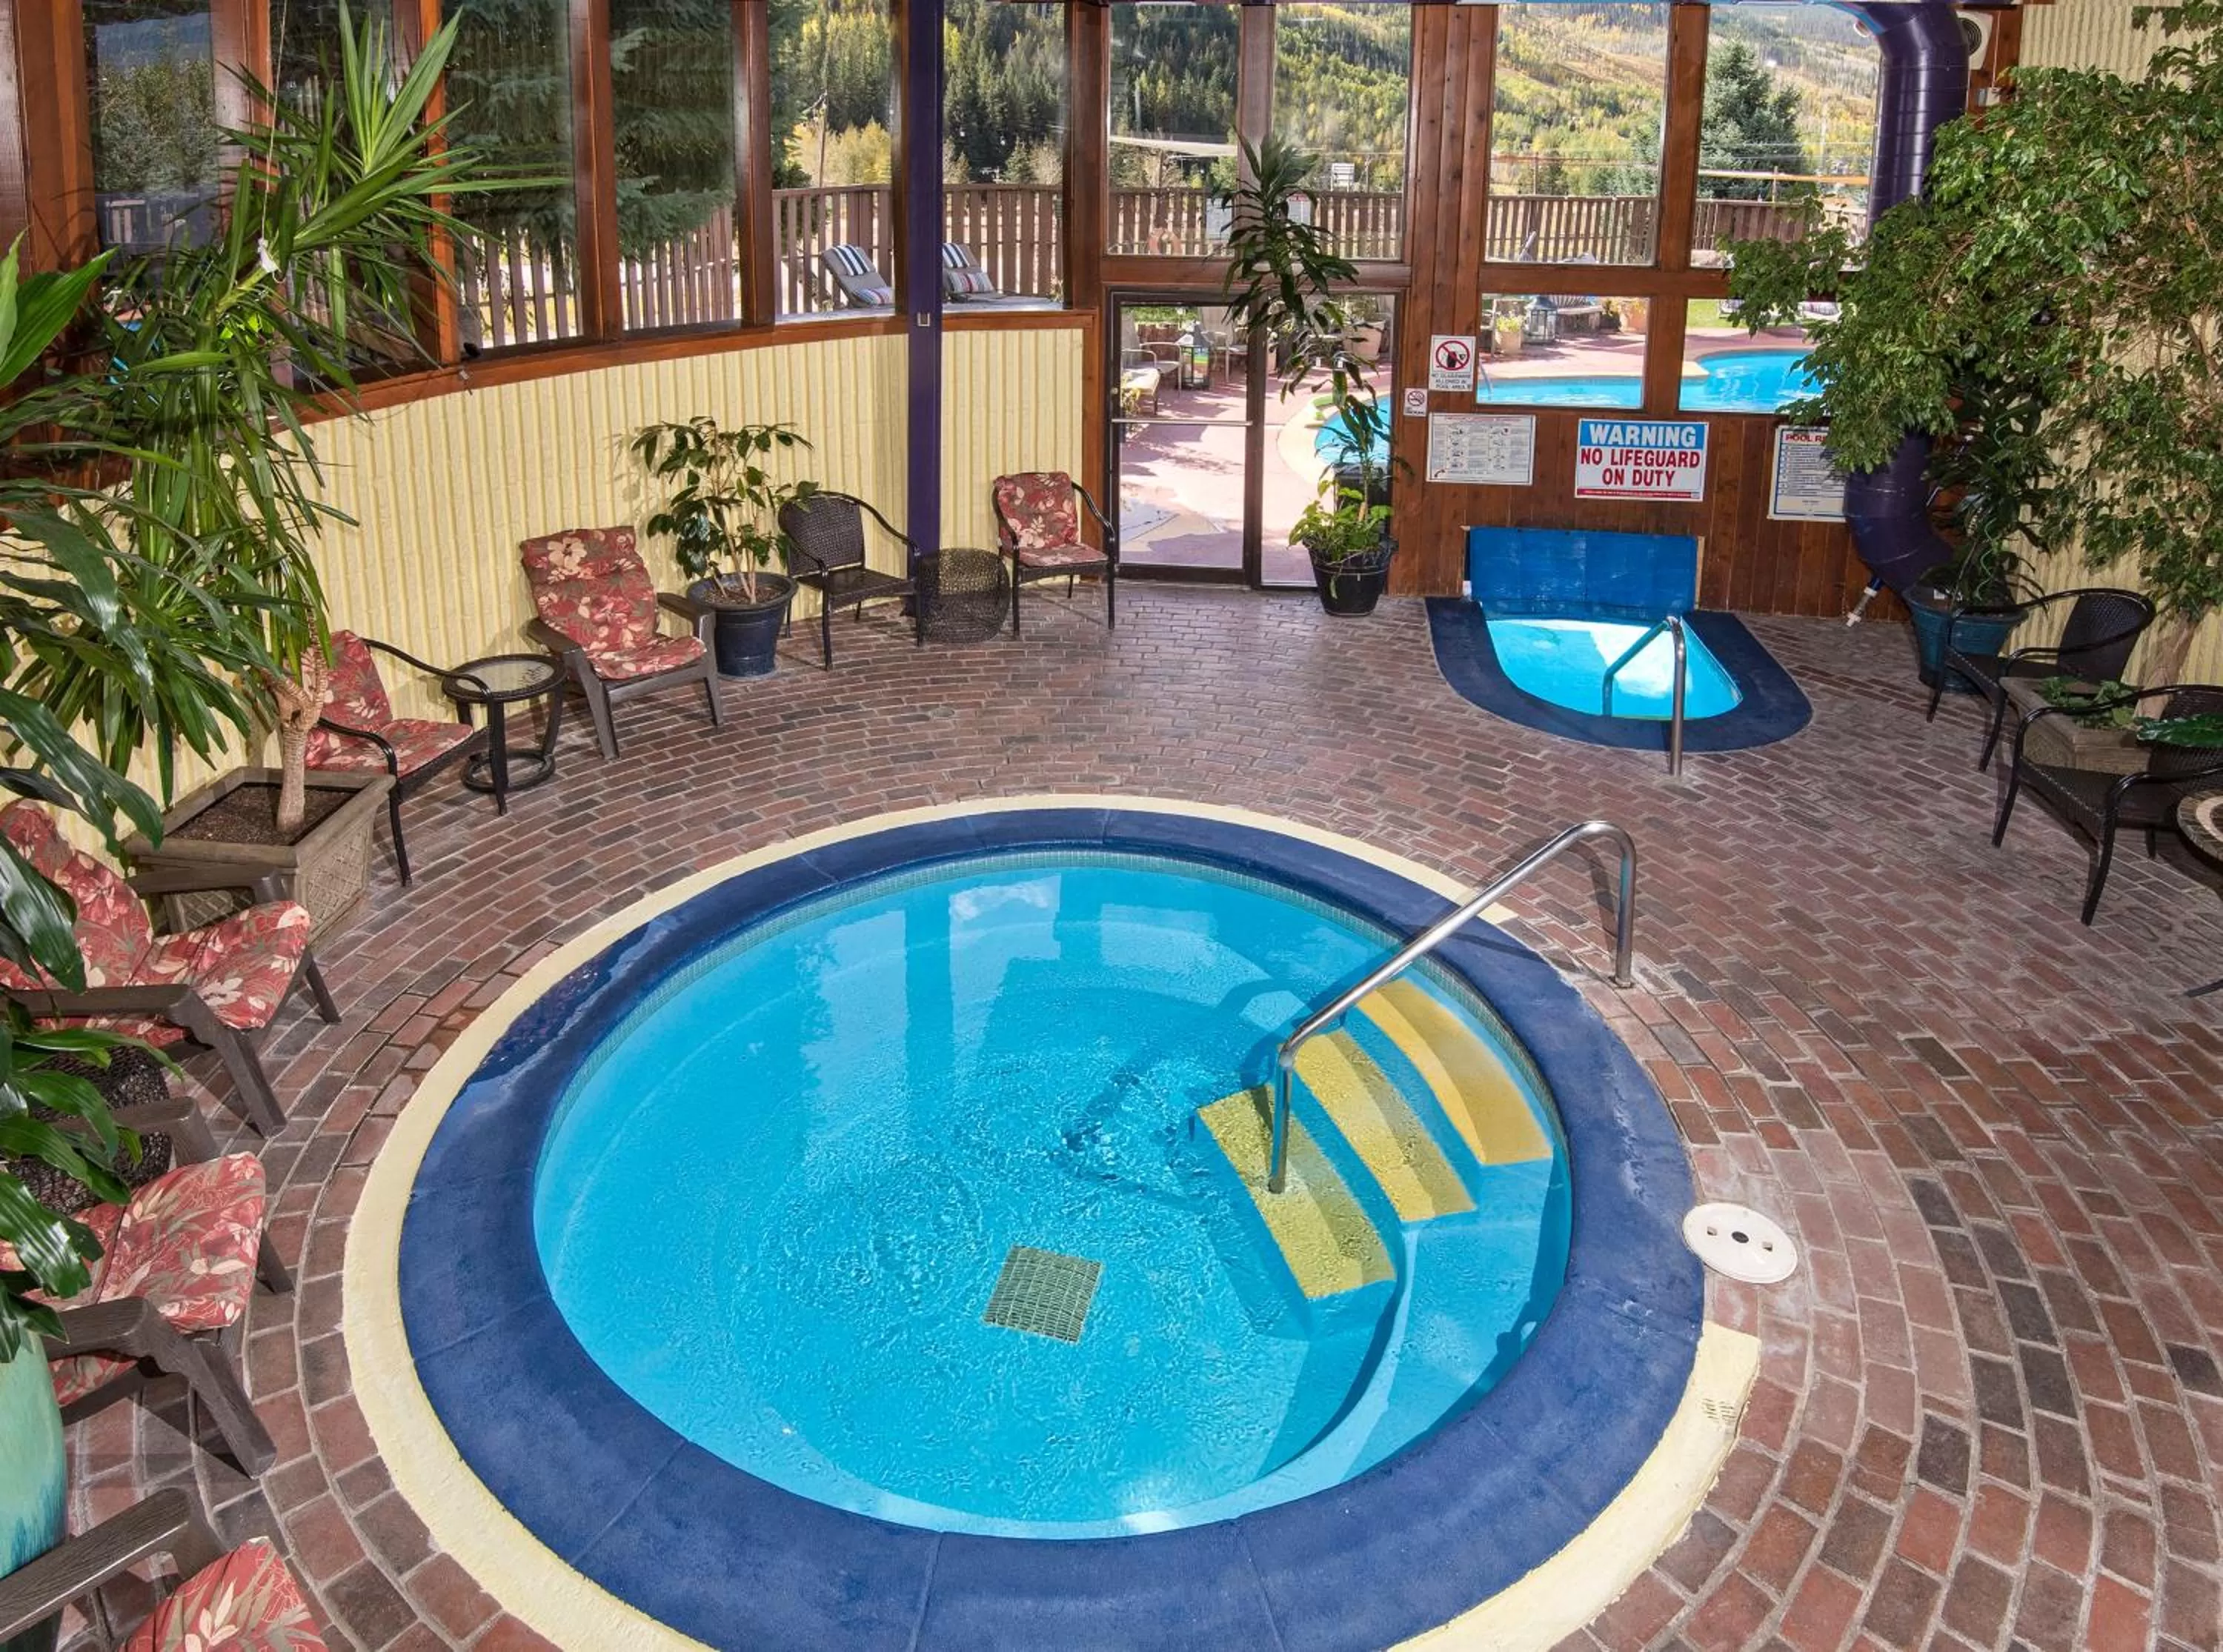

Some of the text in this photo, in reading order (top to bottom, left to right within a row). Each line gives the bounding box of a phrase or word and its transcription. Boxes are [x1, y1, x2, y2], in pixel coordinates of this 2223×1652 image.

[1590, 424, 1695, 447] WARNING
[1785, 433, 1813, 442] POOL
[1581, 448, 1700, 468] NO LIFEGUARD
[1602, 468, 1675, 486] ON DUTY
